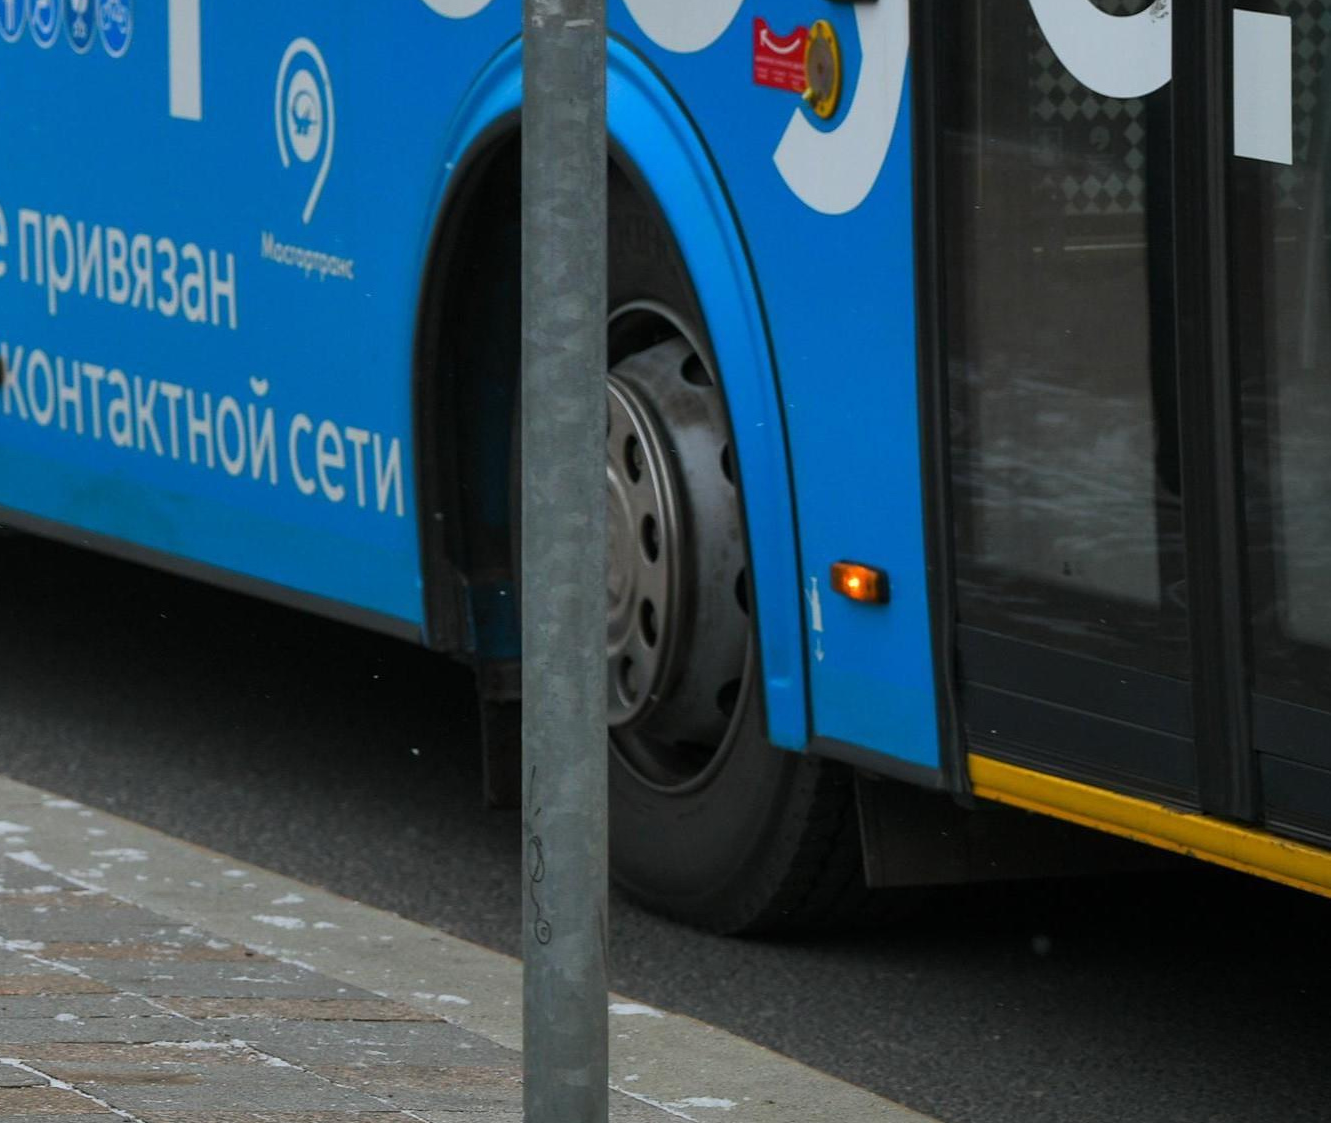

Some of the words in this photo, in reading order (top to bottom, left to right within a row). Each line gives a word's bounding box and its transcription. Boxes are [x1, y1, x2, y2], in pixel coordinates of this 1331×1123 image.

[17, 207, 238, 330] привязан
[260, 230, 354, 283] Мосгортранс
[0, 340, 279, 486] контактной
[288, 412, 405, 518] сети
